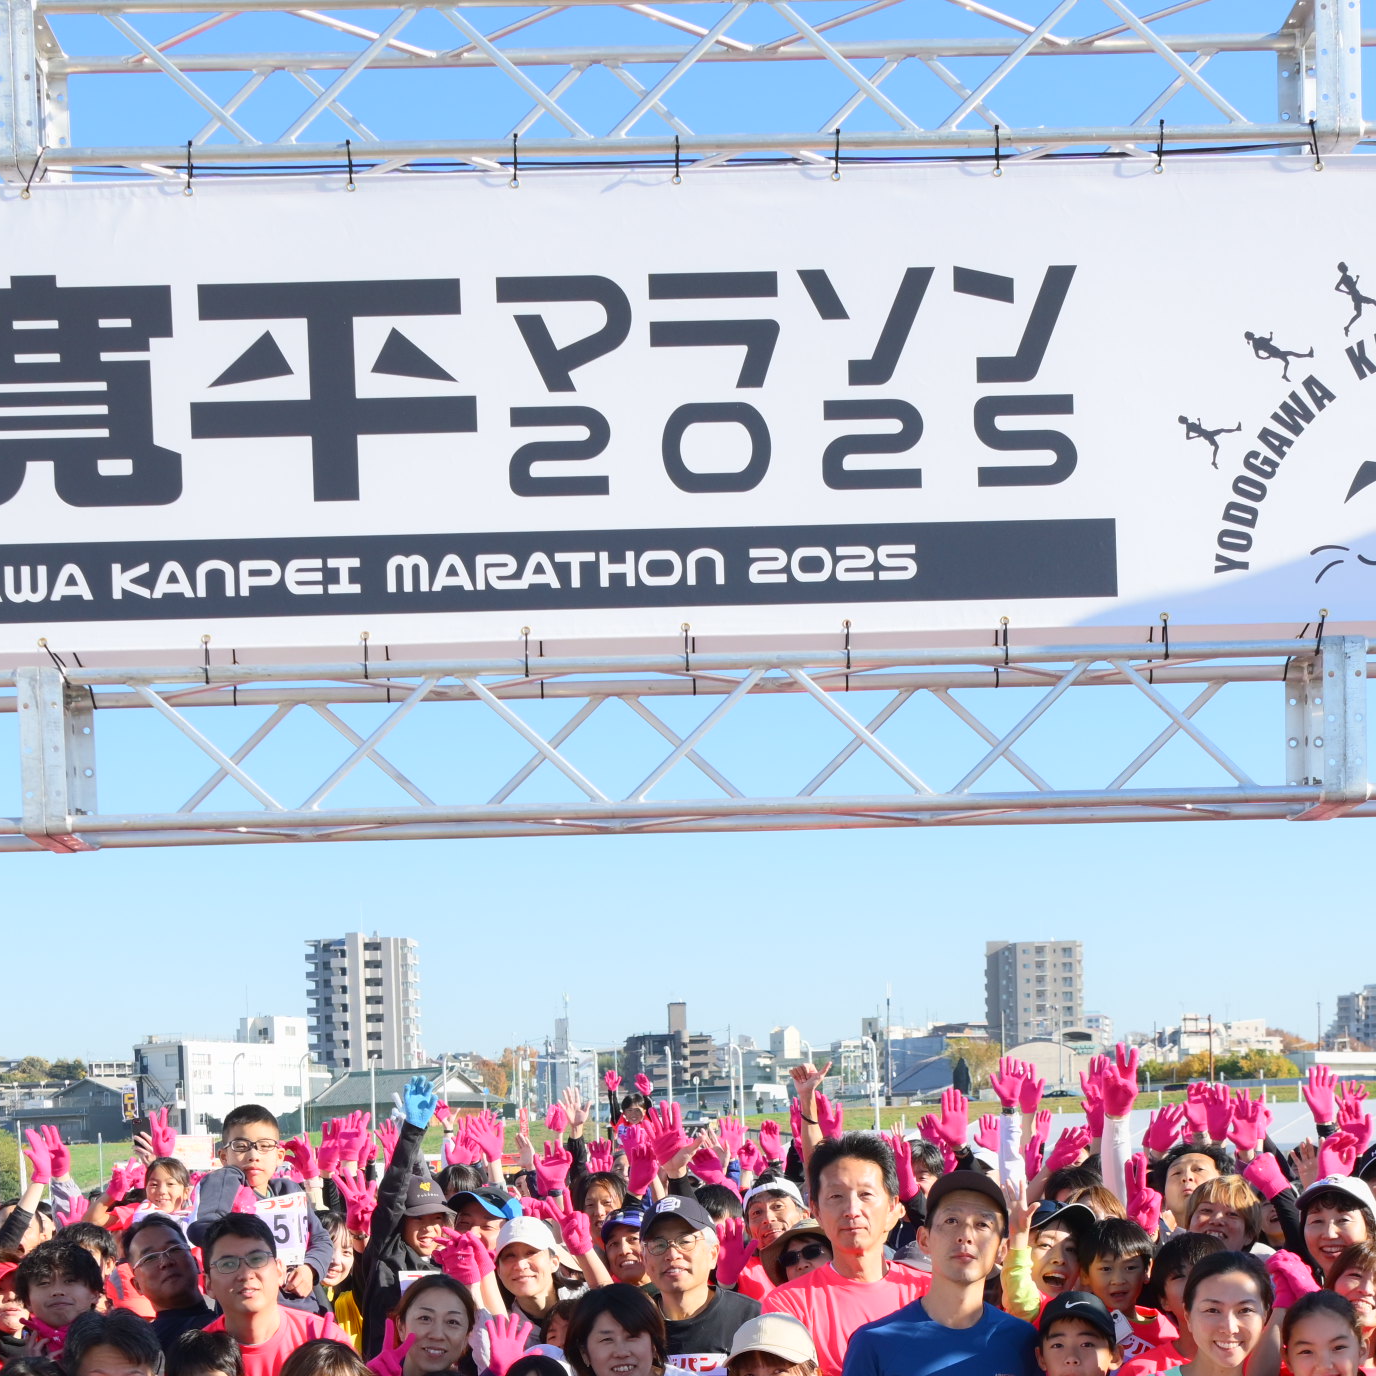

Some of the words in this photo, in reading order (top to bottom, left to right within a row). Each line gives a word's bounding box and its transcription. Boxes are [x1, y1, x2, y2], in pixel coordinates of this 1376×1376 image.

[509, 393, 1079, 498] 2025
[1213, 374, 1337, 575] YODOGAWA
[111, 556, 362, 600] KANPEI
[386, 548, 727, 594] MARATHON
[748, 543, 917, 584] 2025
